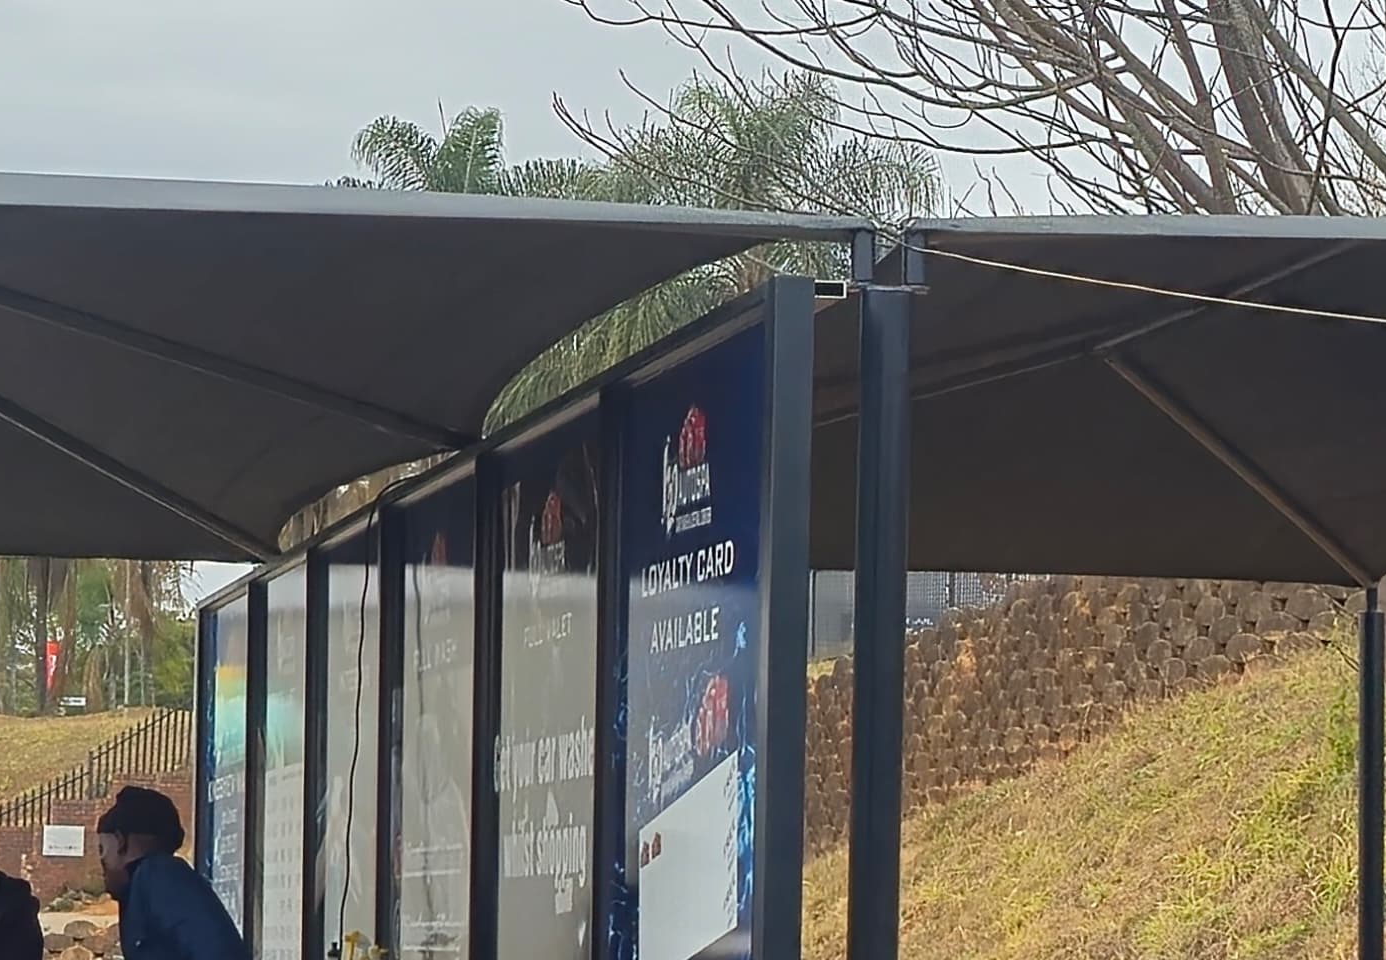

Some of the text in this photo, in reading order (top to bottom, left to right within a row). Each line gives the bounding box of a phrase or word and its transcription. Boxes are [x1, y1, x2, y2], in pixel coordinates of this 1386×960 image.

[641, 540, 734, 598] LOYALTY CARD
[649, 606, 720, 654] AVAILABLE
[537, 736, 557, 785] car
[558, 714, 595, 781] washe
[535, 813, 587, 888] shopping
